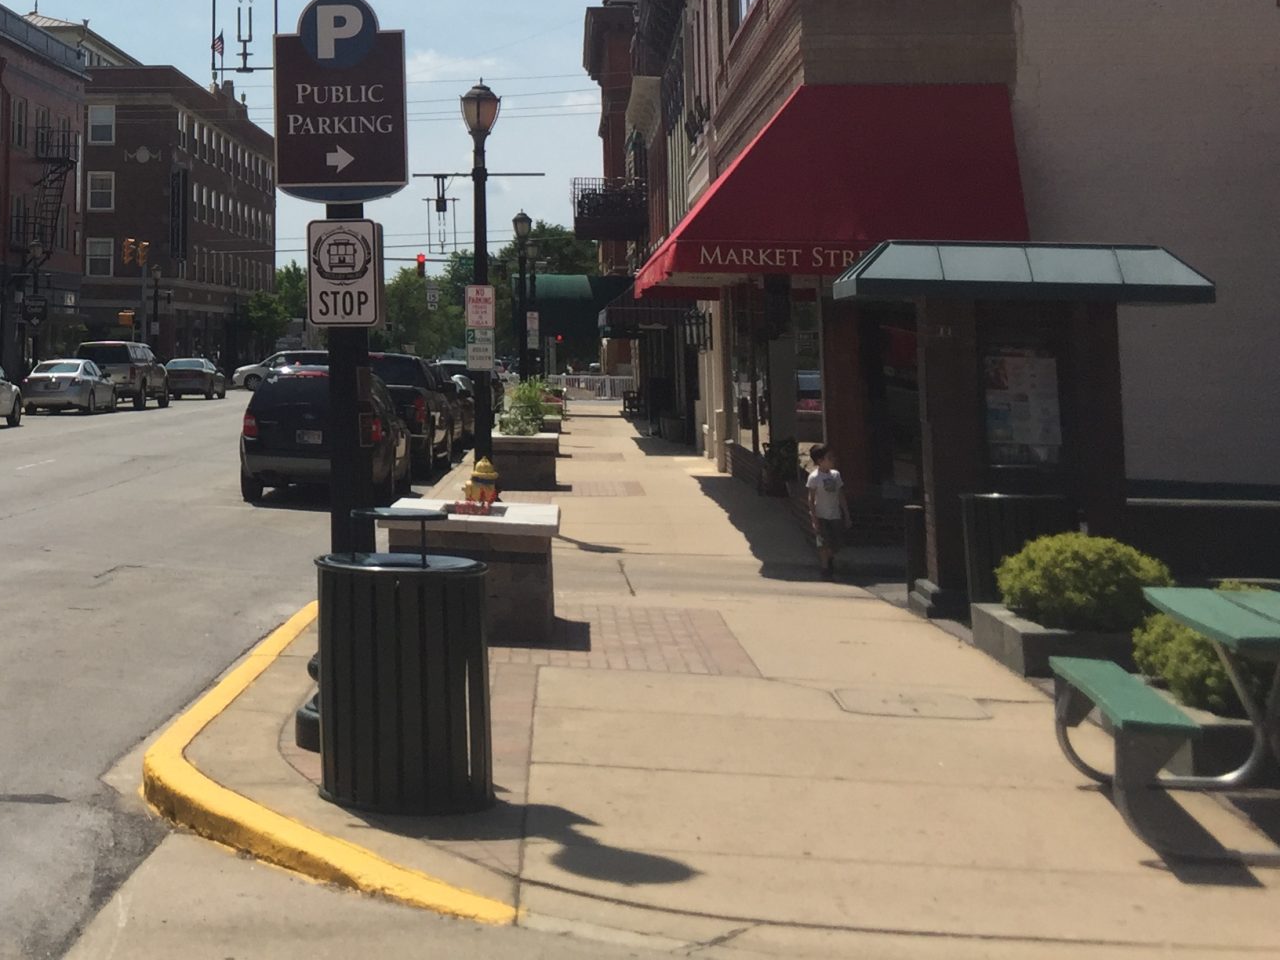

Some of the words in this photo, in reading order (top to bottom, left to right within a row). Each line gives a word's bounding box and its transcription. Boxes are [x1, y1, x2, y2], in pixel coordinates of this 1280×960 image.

[317, 4, 364, 60] P
[296, 83, 384, 105] PUBLIC
[287, 113, 394, 136] PARKING
[698, 245, 803, 267] MARKET
[318, 290, 369, 316] STOP
